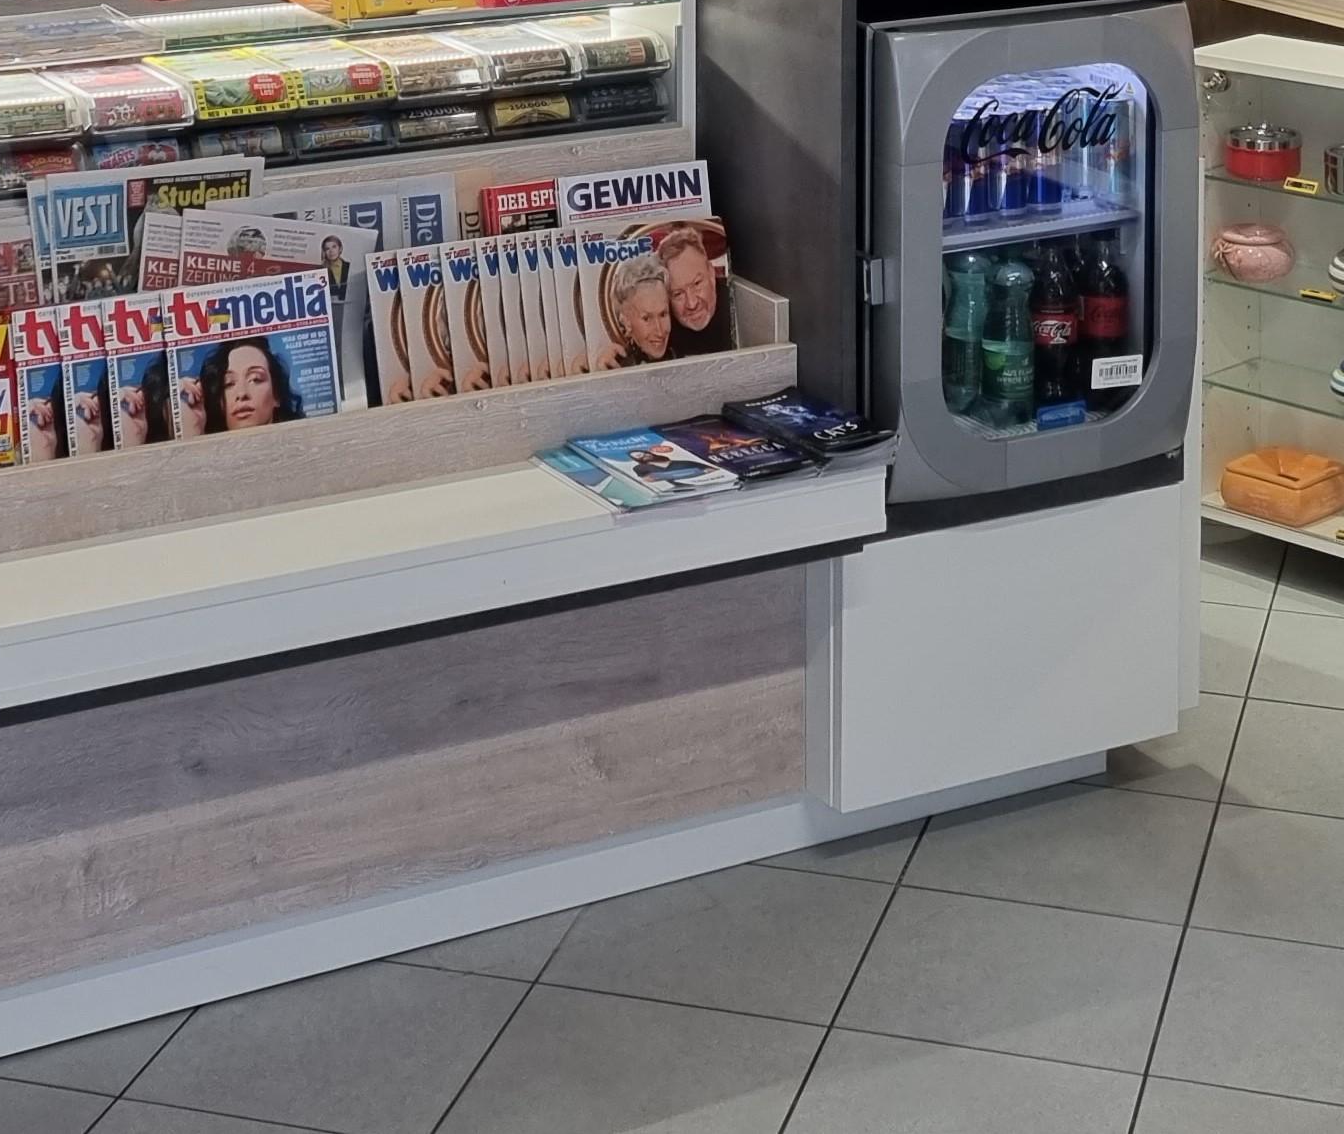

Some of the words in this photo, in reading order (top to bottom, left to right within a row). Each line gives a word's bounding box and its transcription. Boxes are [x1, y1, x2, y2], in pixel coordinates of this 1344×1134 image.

[157, 180, 248, 208] Studenti
[566, 168, 702, 213] GEWINN
[496, 193, 525, 213] DER
[57, 194, 119, 238] VESTI
[186, 255, 242, 272] KLEINE
[813, 420, 858, 442] CATS
[708, 442, 785, 464] REBECCA
